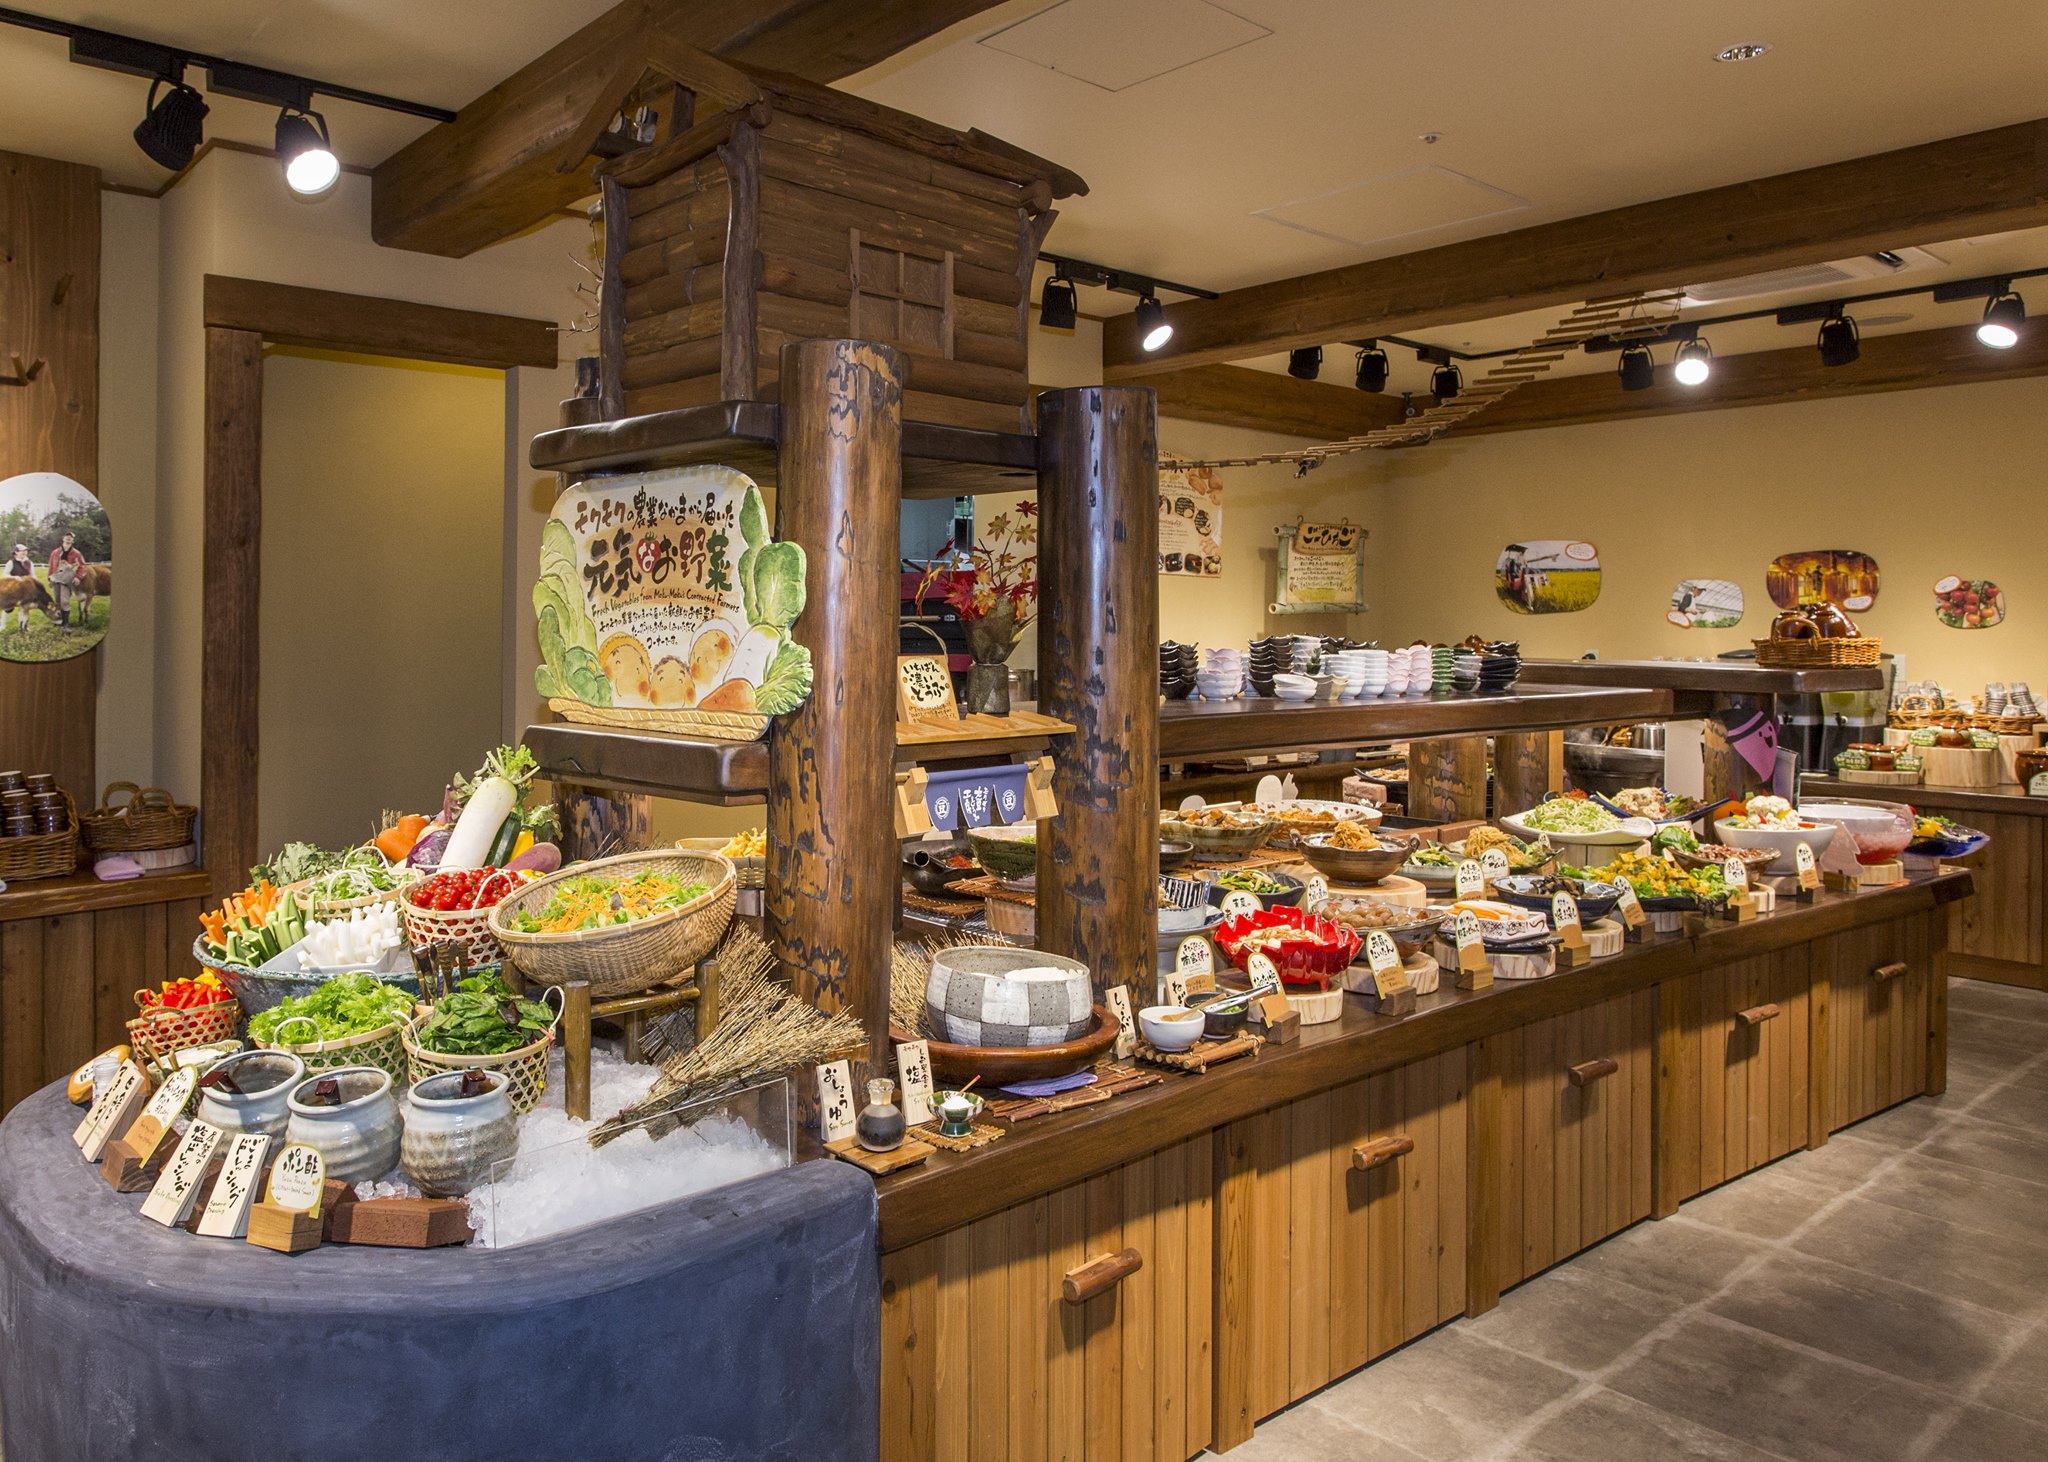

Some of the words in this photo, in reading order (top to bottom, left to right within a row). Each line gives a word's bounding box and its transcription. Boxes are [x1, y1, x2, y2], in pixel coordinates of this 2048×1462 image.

[575, 486, 734, 534] モクモクの農業なかまから届いた
[584, 527, 732, 599] 元気なお野菜
[640, 586, 653, 600] from
[717, 593, 740, 613] Farmers
[903, 662, 941, 674] いちばん
[909, 672, 933, 688] 濃い
[911, 682, 945, 702] とうふ
[963, 789, 972, 815] 工房
[1113, 992, 1131, 1032] しょうが
[906, 1066, 921, 1084] 塩
[824, 1066, 848, 1121] おしょうゆ
[226, 1138, 251, 1208] ドレッシング
[283, 1148, 318, 1177] ポン酢
